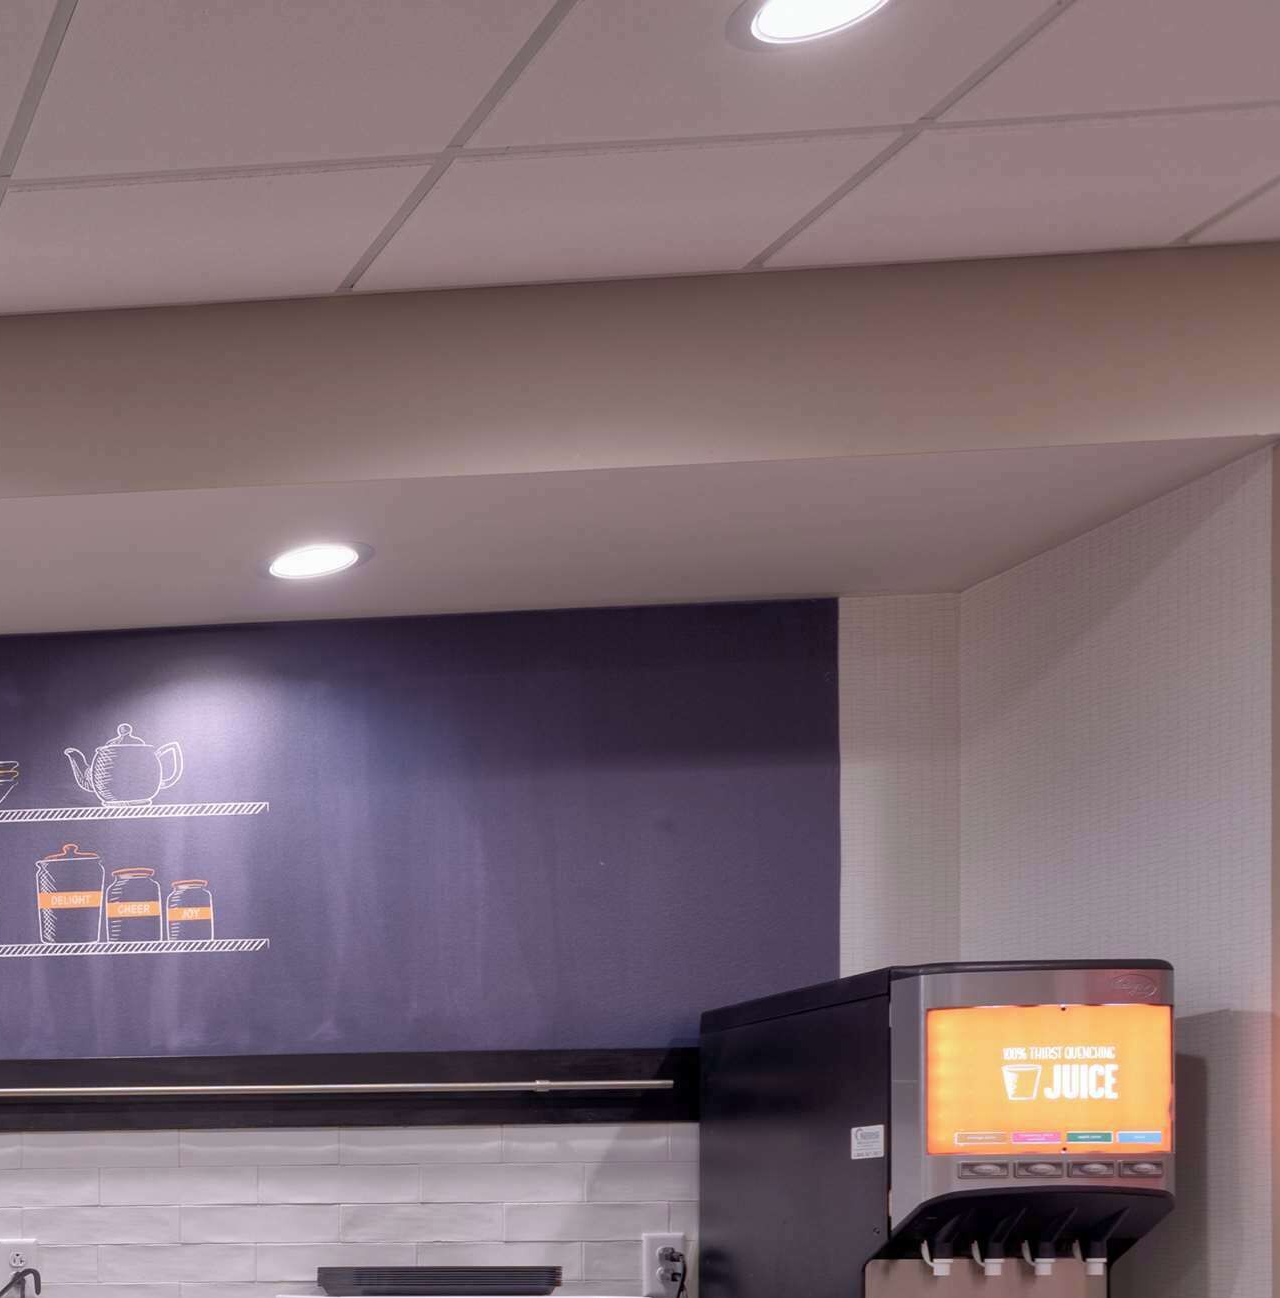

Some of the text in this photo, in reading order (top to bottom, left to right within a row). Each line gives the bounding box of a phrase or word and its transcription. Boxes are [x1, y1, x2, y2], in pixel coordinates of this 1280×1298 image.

[51, 894, 91, 906] DELIGHT
[117, 904, 151, 915] CHEER
[180, 907, 200, 918] JOY
[1028, 1046, 1061, 1061] THIRST
[1043, 1063, 1120, 1100] JUICE
